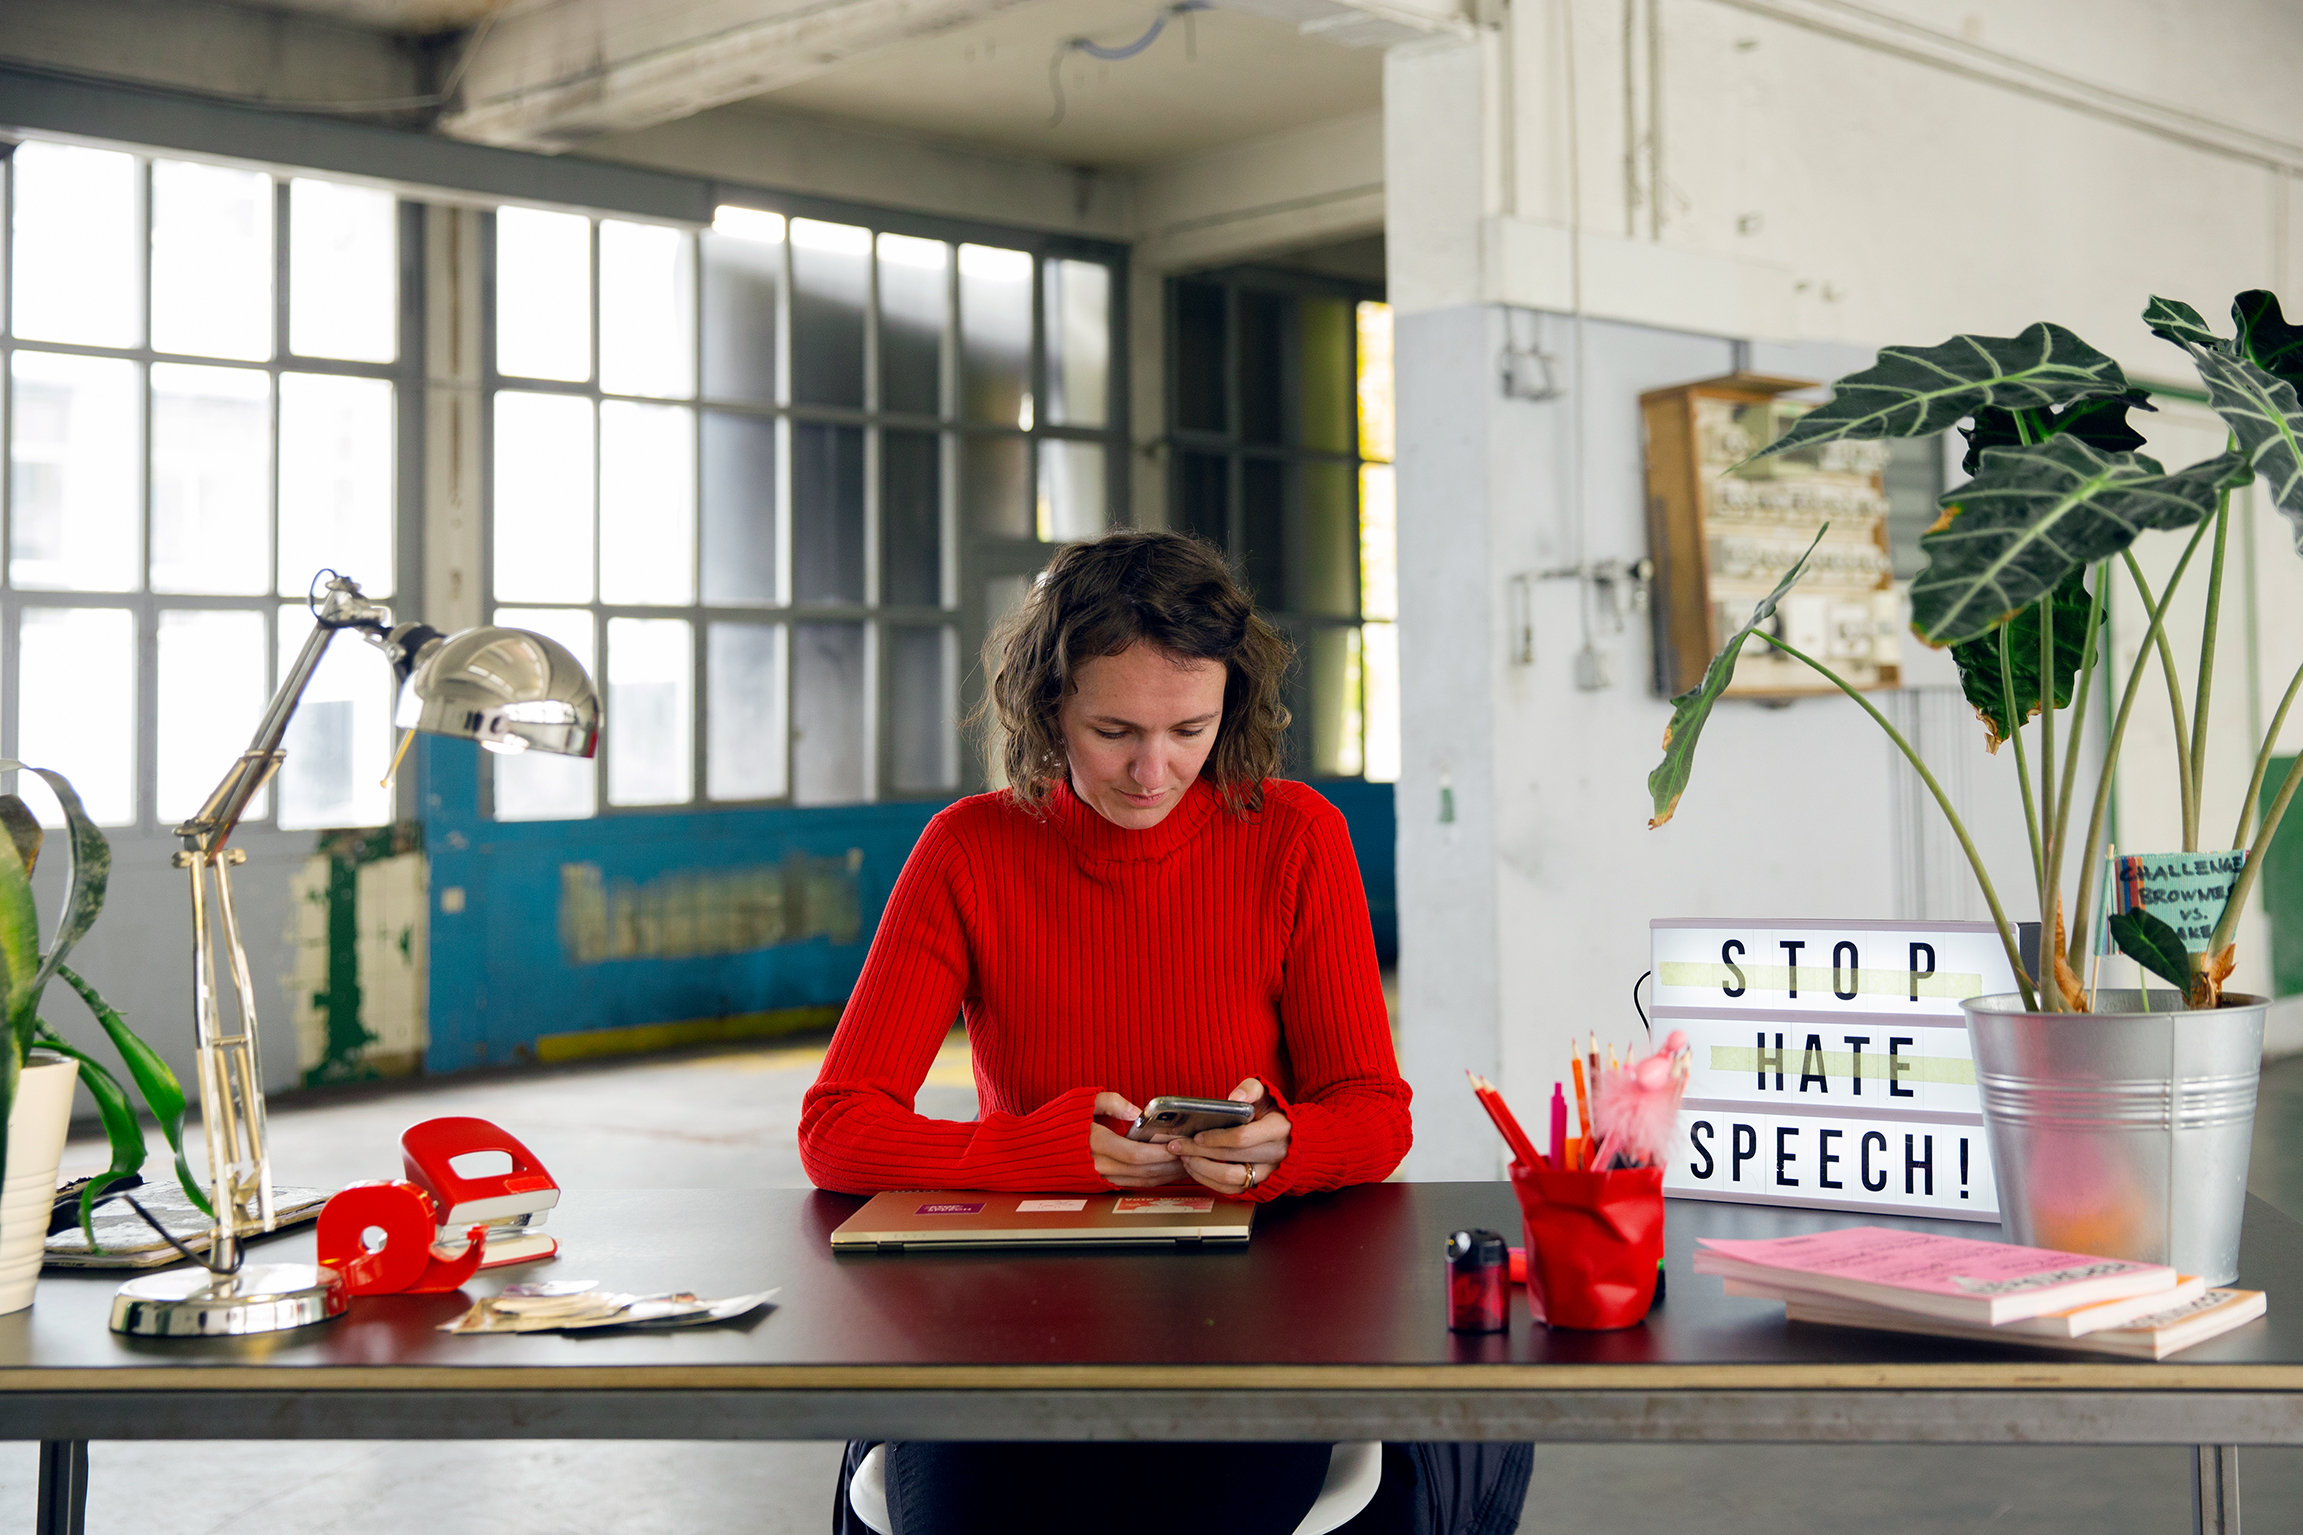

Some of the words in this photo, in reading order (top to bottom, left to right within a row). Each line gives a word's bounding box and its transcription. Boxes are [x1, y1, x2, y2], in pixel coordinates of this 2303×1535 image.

[2120, 856, 2242, 882] CHALLENGE
[2177, 924, 2212, 941] AKE
[1721, 939, 1936, 1002] STOP
[1757, 1032, 1914, 1097] HATE
[1690, 1120, 1969, 1199] SPEECH!
